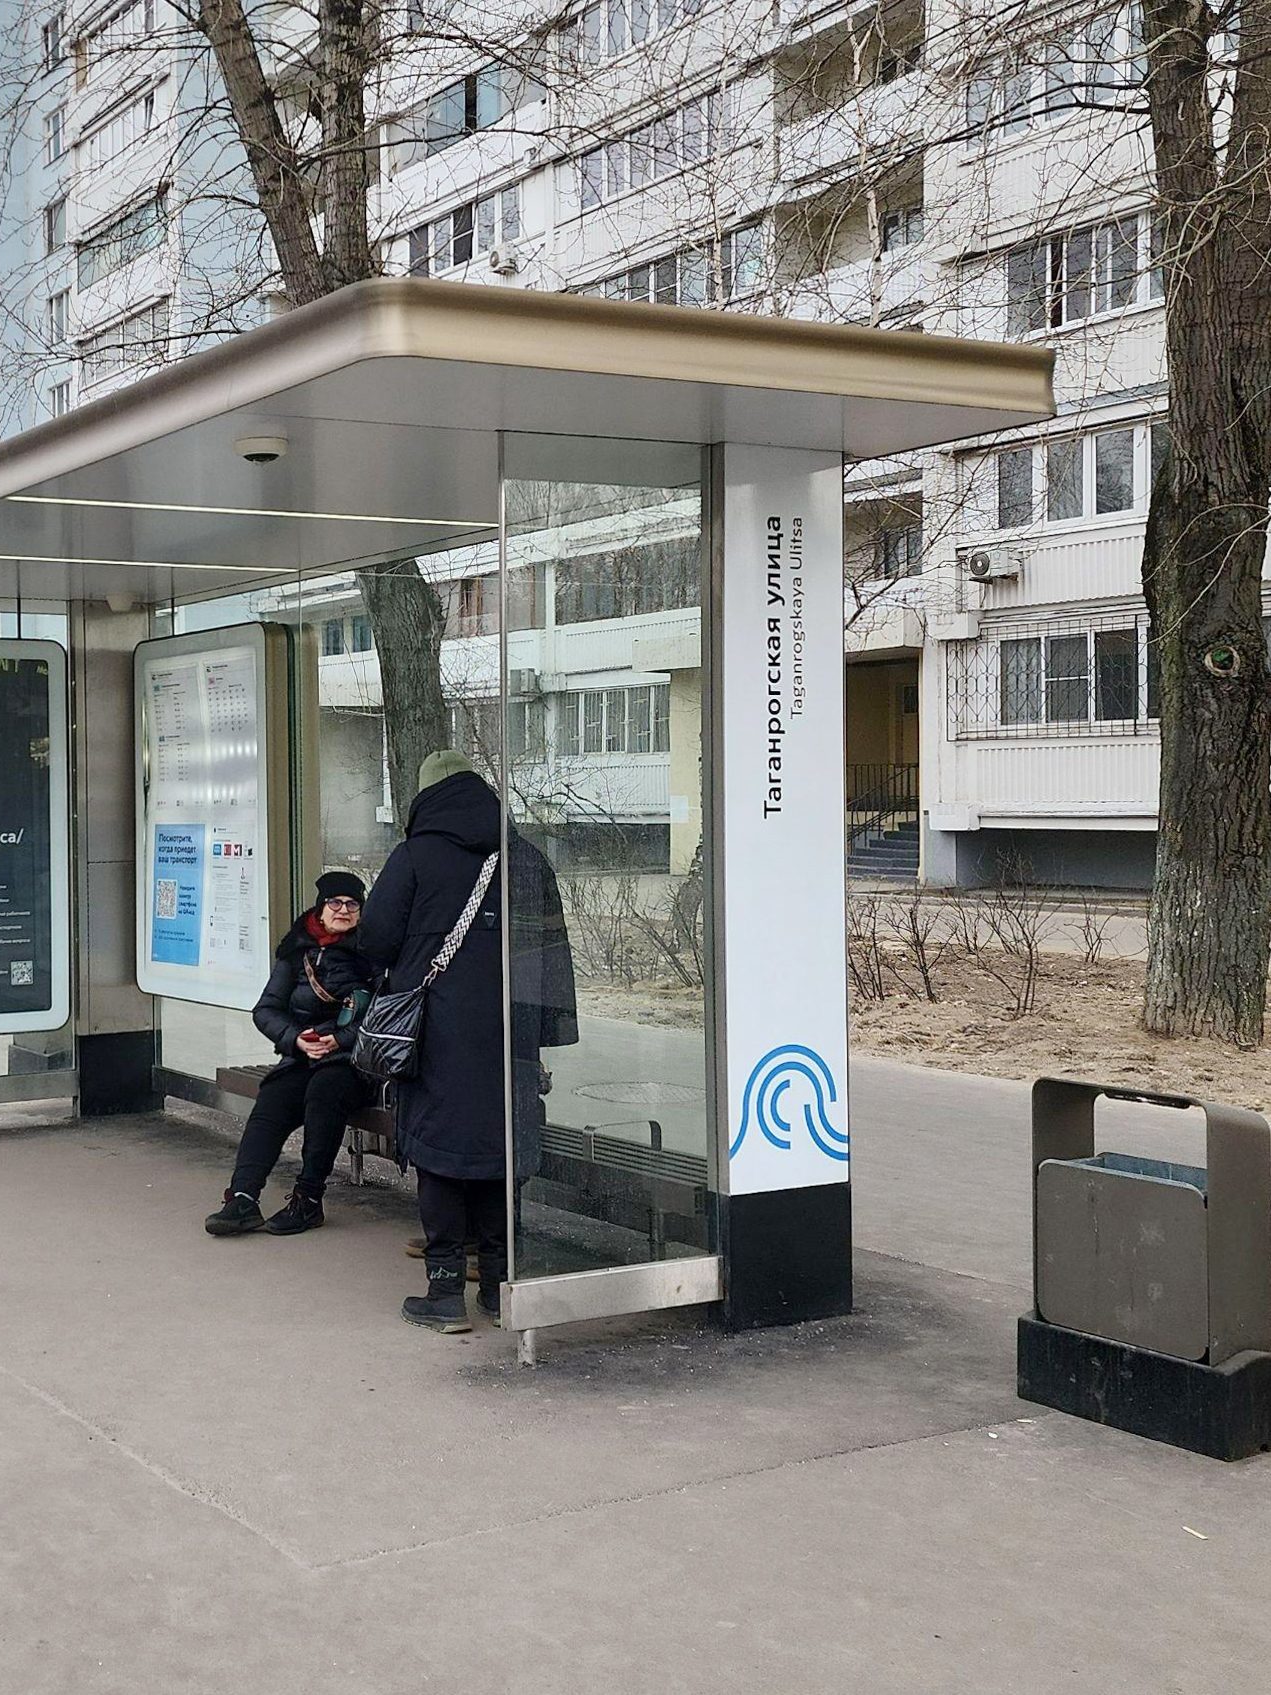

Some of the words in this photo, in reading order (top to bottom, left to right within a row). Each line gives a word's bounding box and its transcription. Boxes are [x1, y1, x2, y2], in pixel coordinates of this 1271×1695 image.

[766, 516, 786, 606] улица
[789, 517, 803, 570] Ulitsa
[789, 577, 806, 720] Taganrogskaya
[764, 617, 786, 819] Таганрогская
